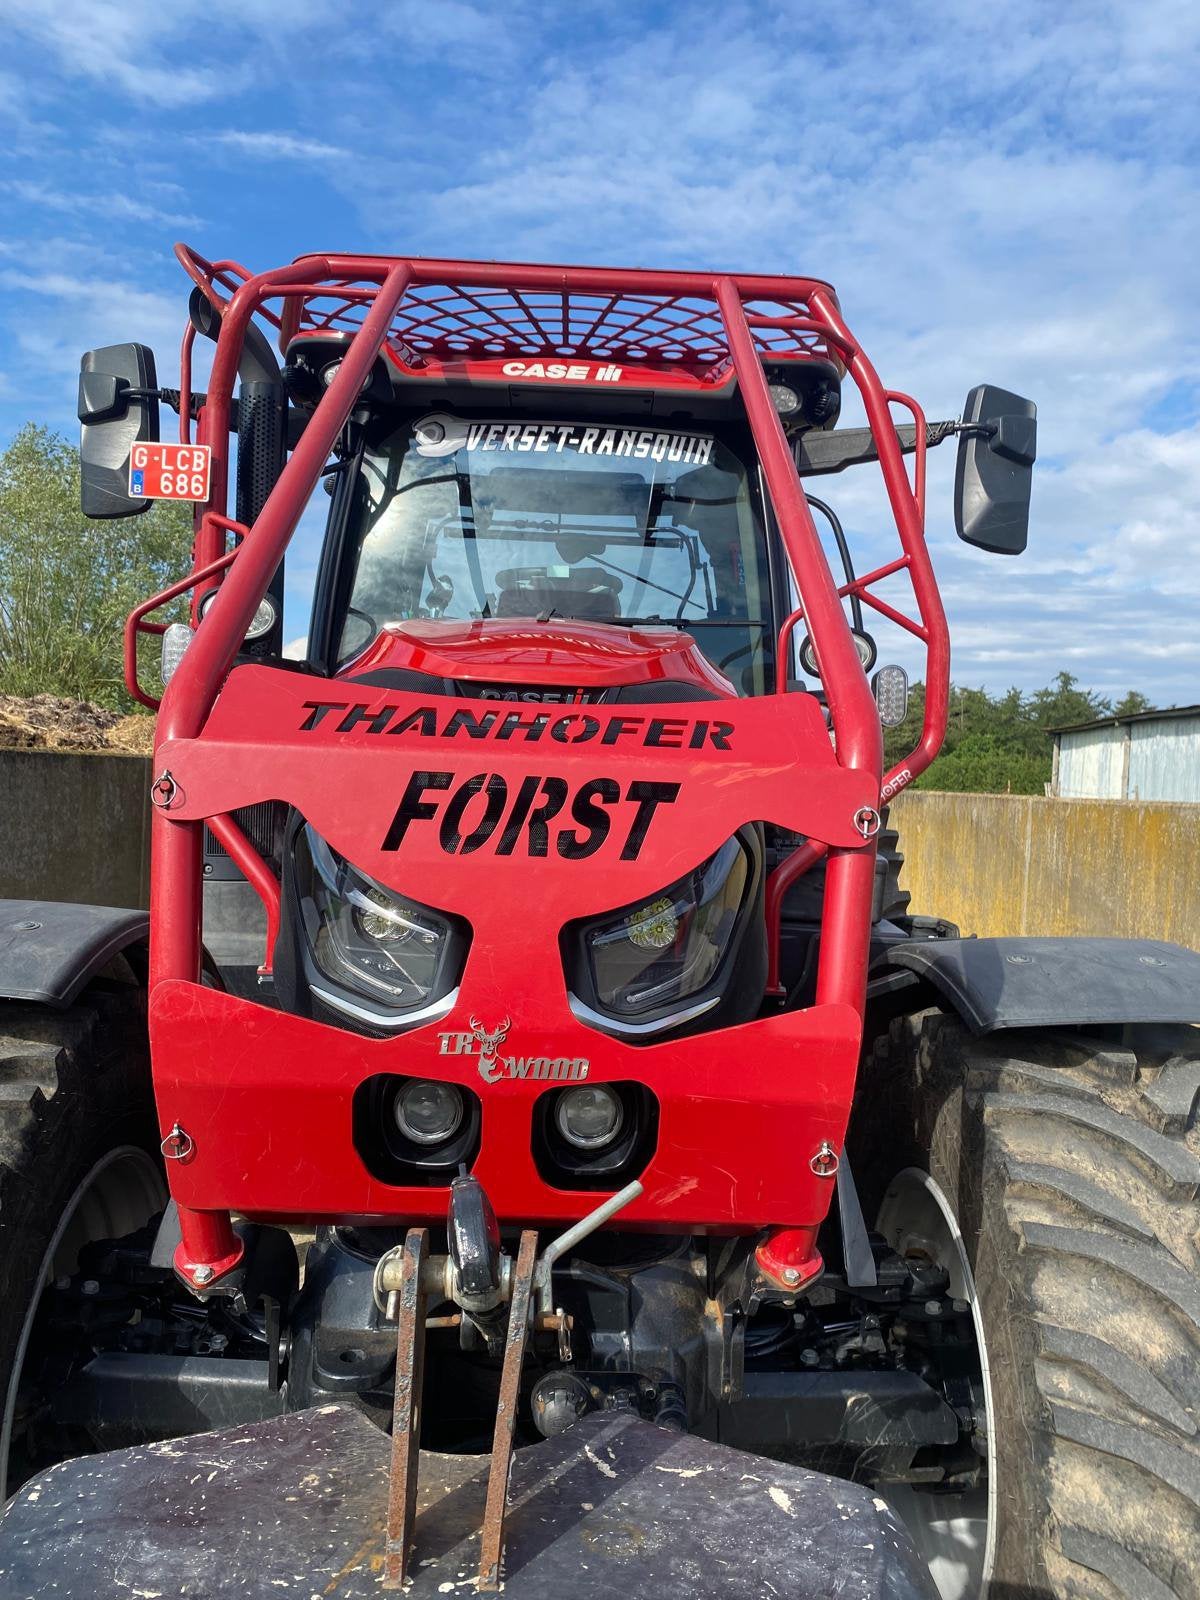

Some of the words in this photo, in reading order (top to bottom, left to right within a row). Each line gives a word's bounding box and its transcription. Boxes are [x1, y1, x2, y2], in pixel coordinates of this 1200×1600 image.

[502, 362, 591, 380] CASE
[465, 423, 714, 465] VERSET-RANSQUIN
[133, 484, 142, 493] B
[160, 473, 204, 496] 686
[298, 700, 736, 751] THANHOFER
[380, 770, 682, 862] FORST
[505, 1056, 590, 1081] WOOD
